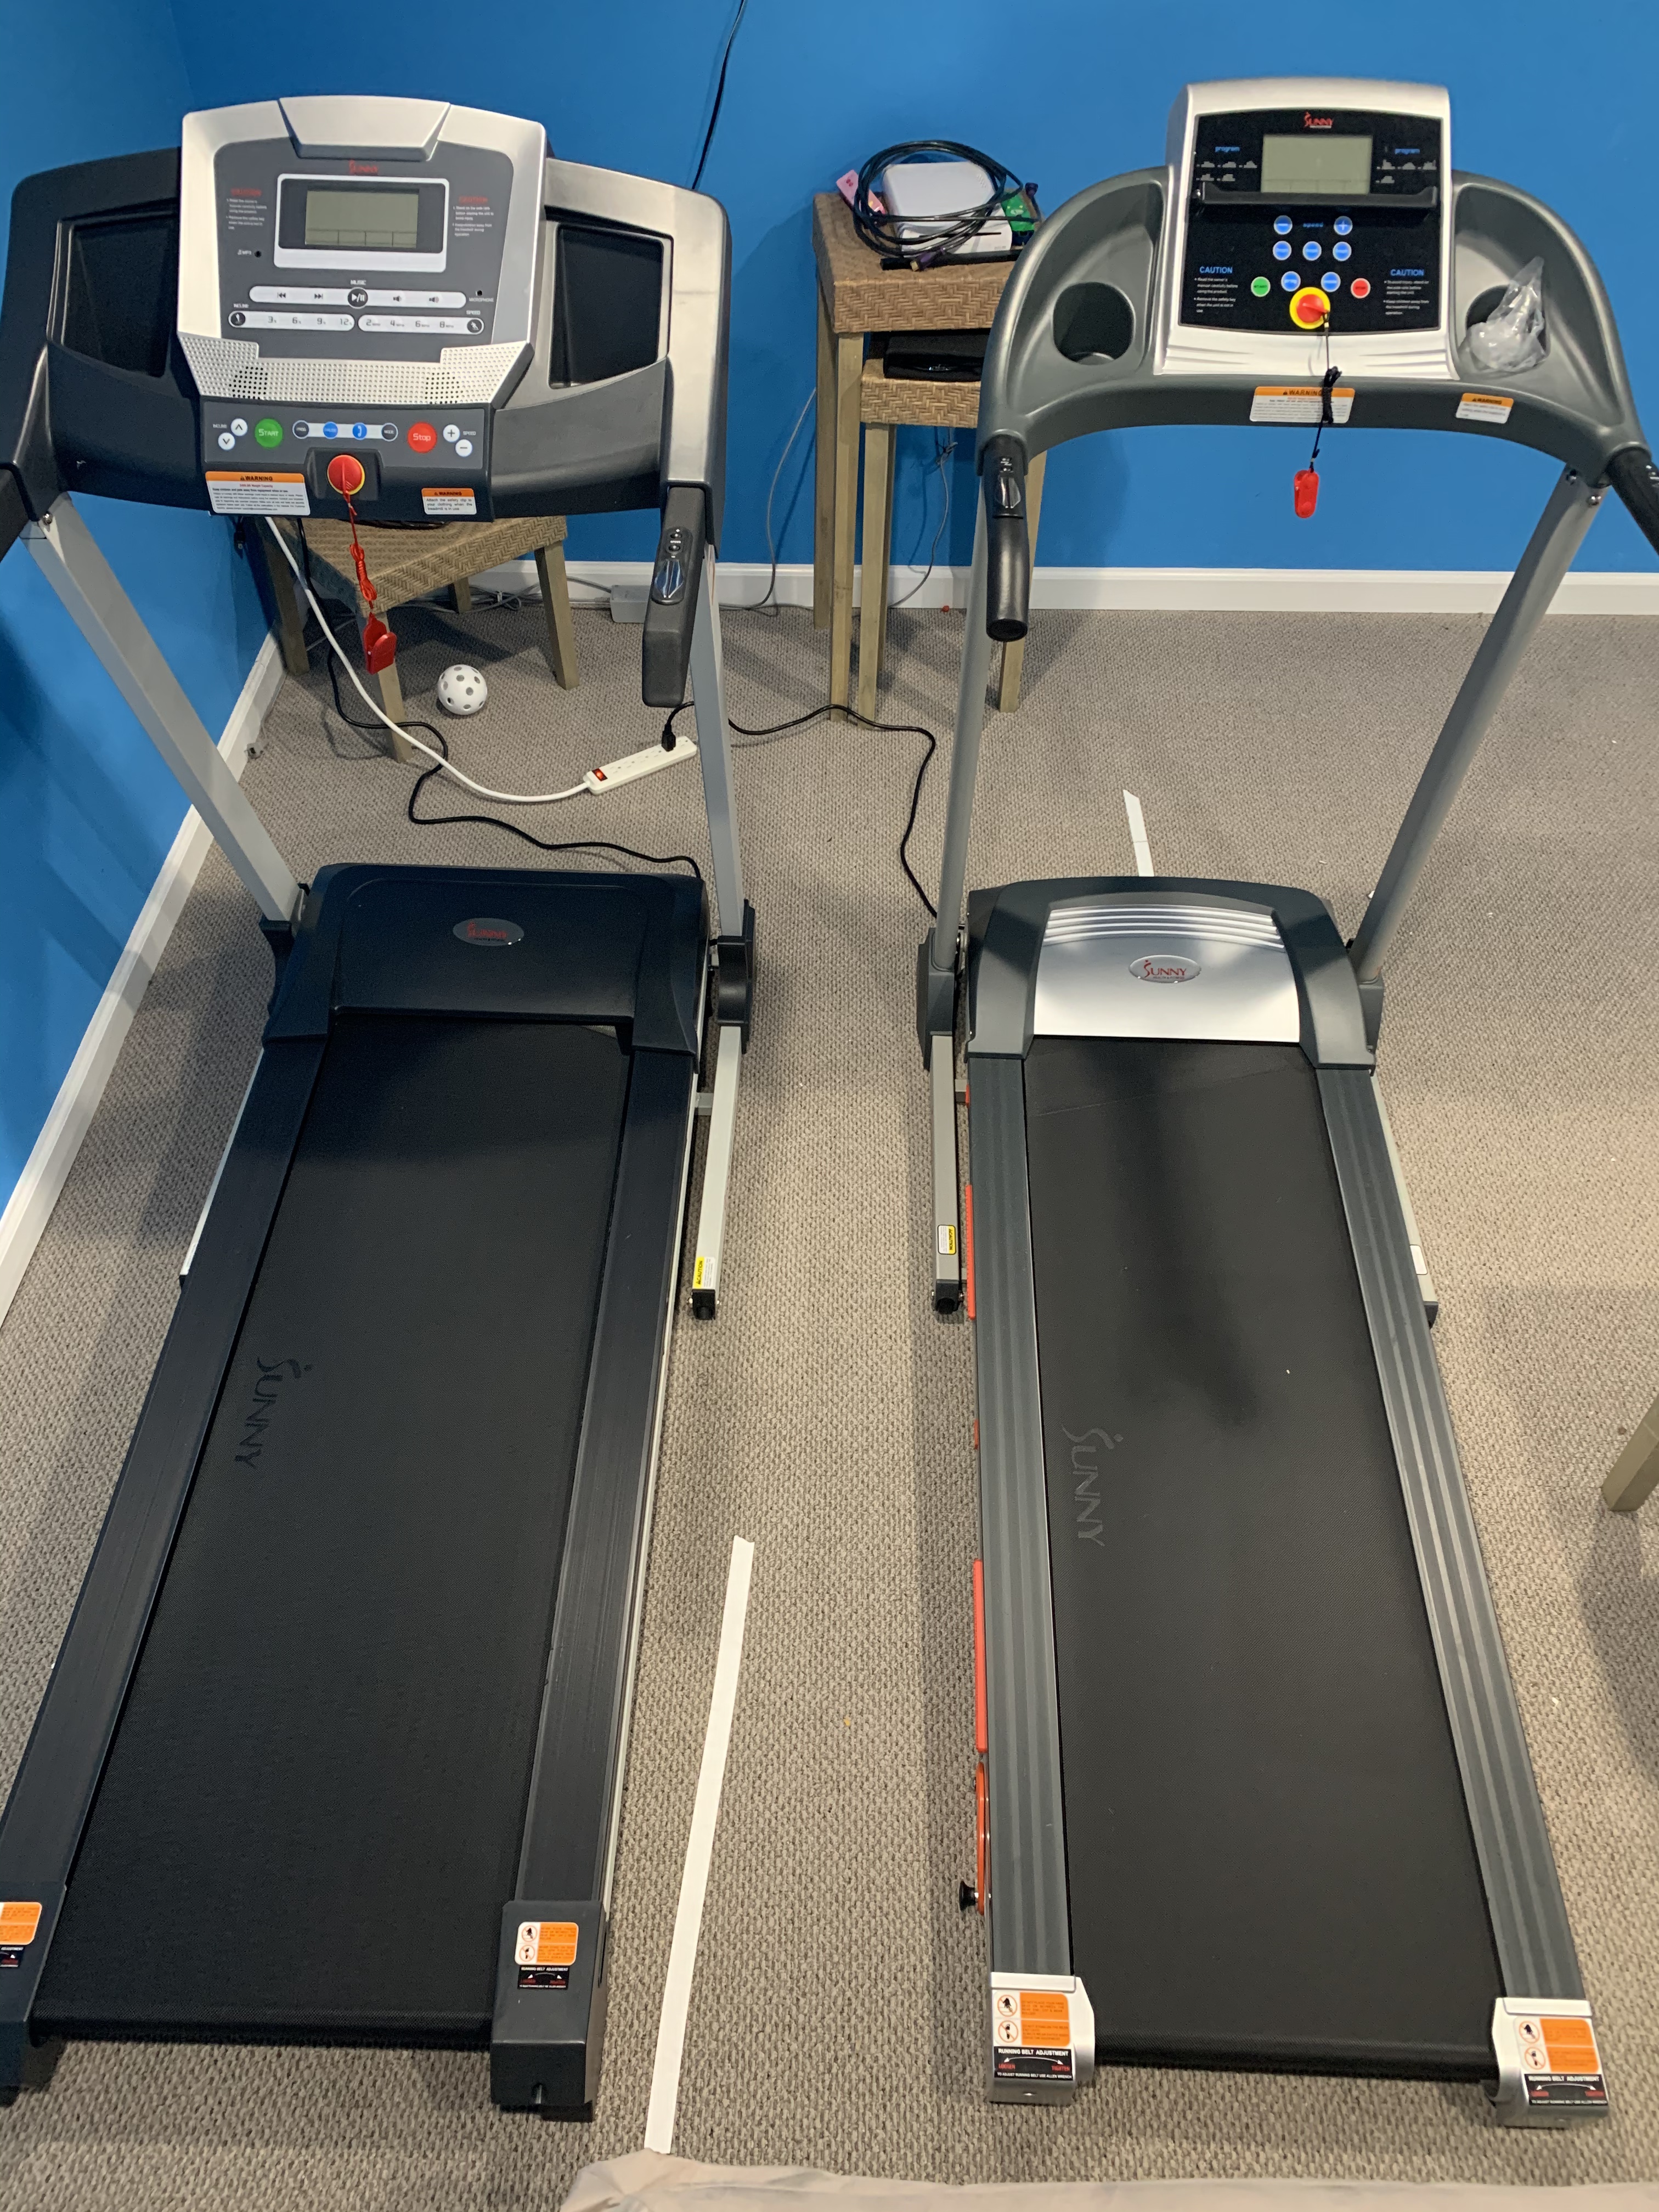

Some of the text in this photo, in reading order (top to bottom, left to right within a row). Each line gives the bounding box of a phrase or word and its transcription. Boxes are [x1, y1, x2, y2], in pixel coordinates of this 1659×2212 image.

[413, 433, 431, 442] Stop
[1143, 960, 1187, 978] SUNNY
[234, 1357, 313, 1470] SUNNY
[1062, 1423, 1124, 1547] SUNNY
